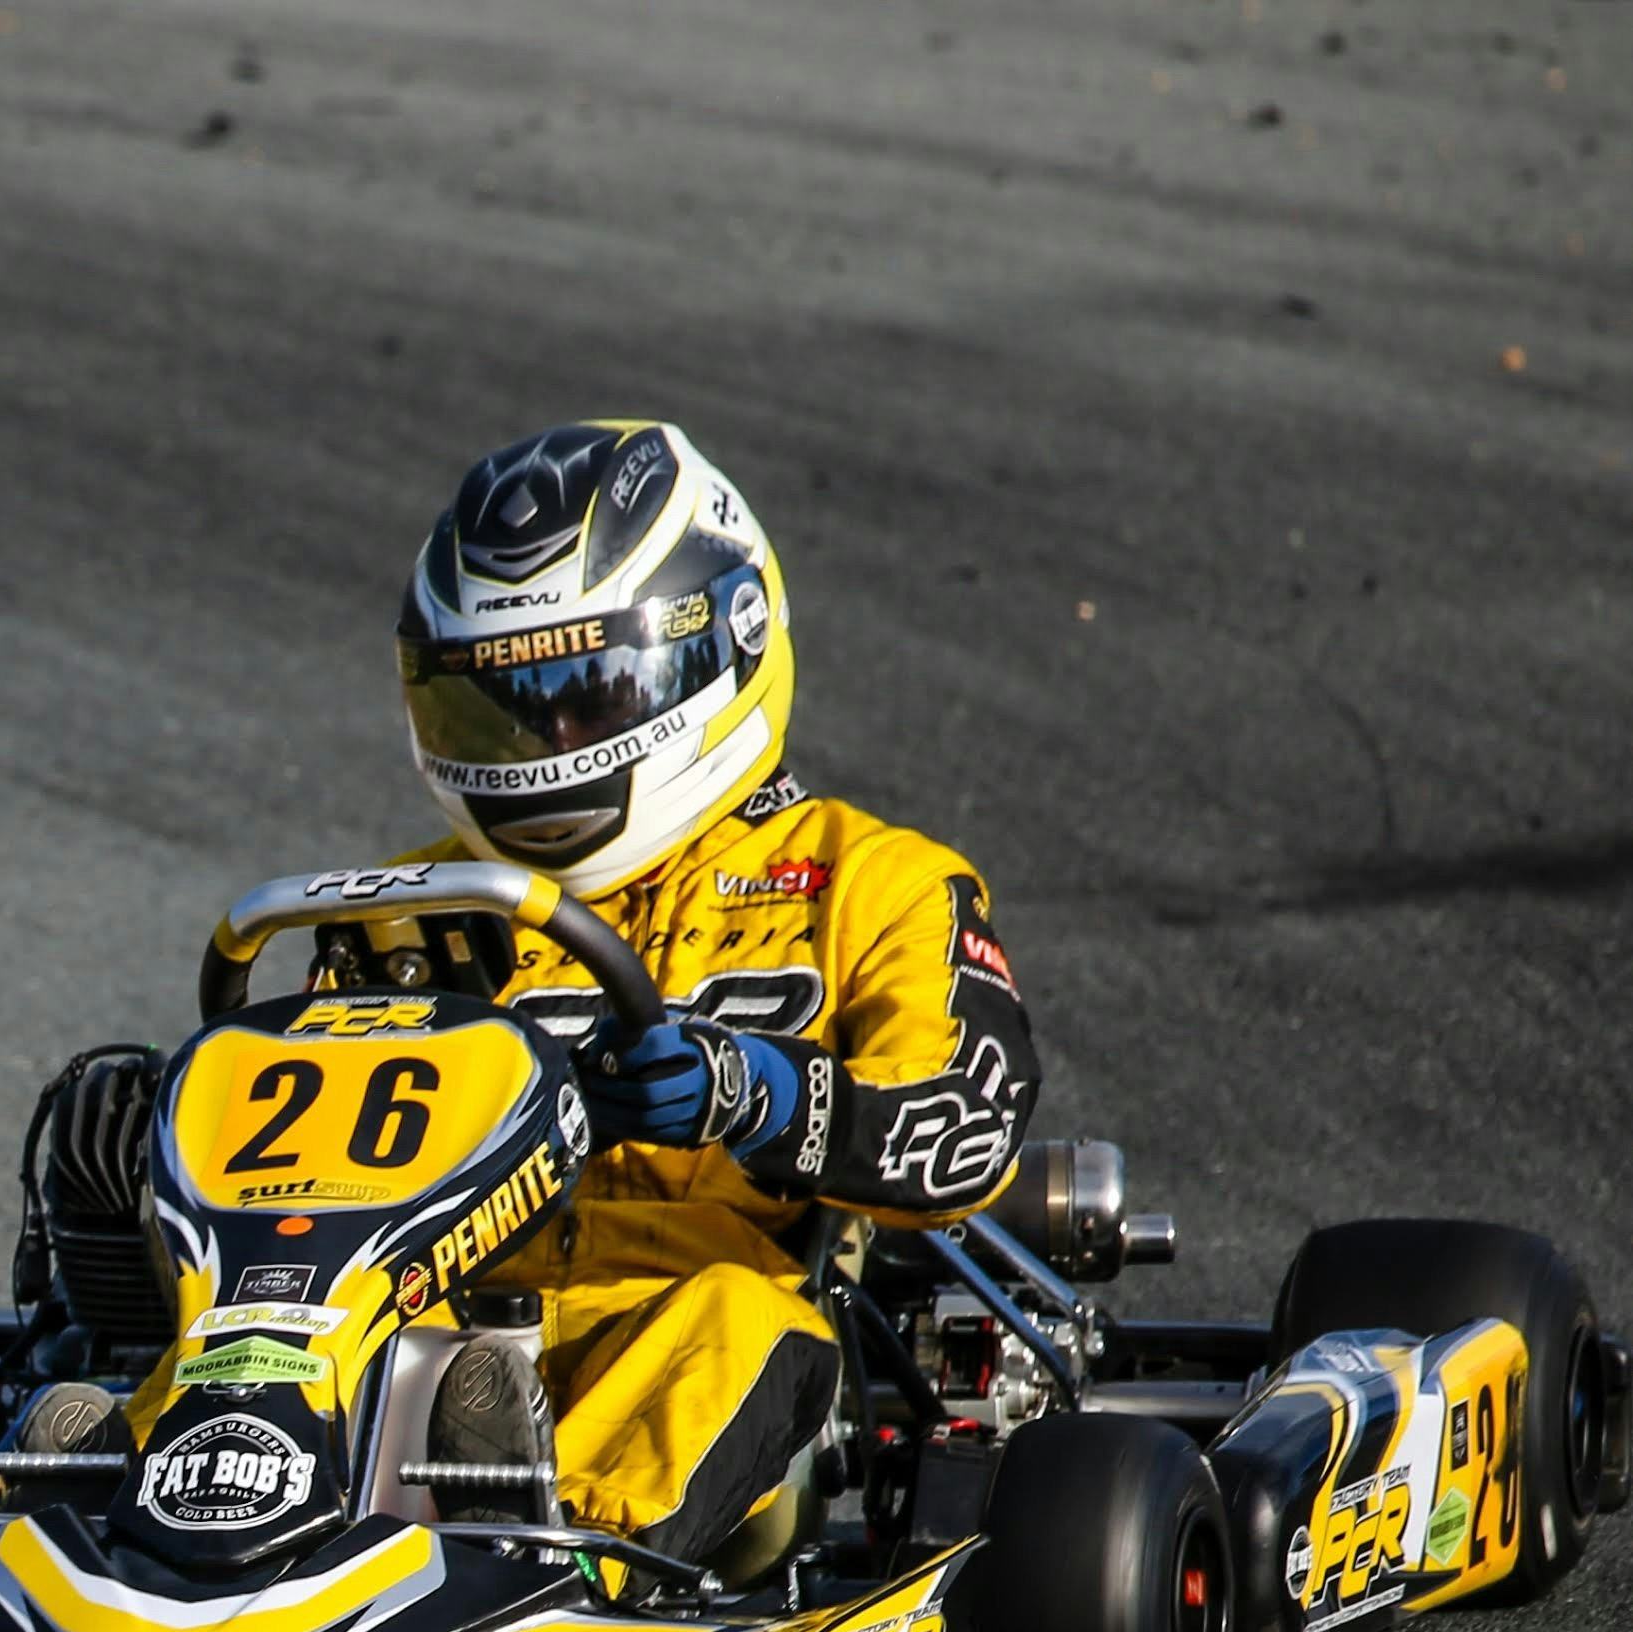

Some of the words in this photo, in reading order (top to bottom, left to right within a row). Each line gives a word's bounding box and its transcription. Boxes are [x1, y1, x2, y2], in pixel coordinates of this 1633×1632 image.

[610, 441, 662, 511] REEVU
[475, 591, 561, 615] REEVU
[473, 618, 607, 671] PENRITE
[305, 862, 436, 899] PCR
[714, 871, 811, 898] VINCI
[285, 1001, 438, 1037] PCR
[222, 1056, 441, 1176] 26
[794, 1056, 835, 1178] sparco
[431, 1140, 564, 1294] PENRITE
[244, 1278, 302, 1291] TIMBER
[201, 1307, 275, 1331] LCR
[182, 1354, 270, 1377] MOORABBIN
[272, 1357, 319, 1375] SIGNS
[178, 1421, 287, 1457] HAMBURGERS
[140, 1452, 211, 1505] FAT
[211, 1449, 312, 1504] BOB'S
[175, 1507, 213, 1520] COLD
[216, 1506, 259, 1520] BEER
[1311, 1482, 1406, 1601] PCR
